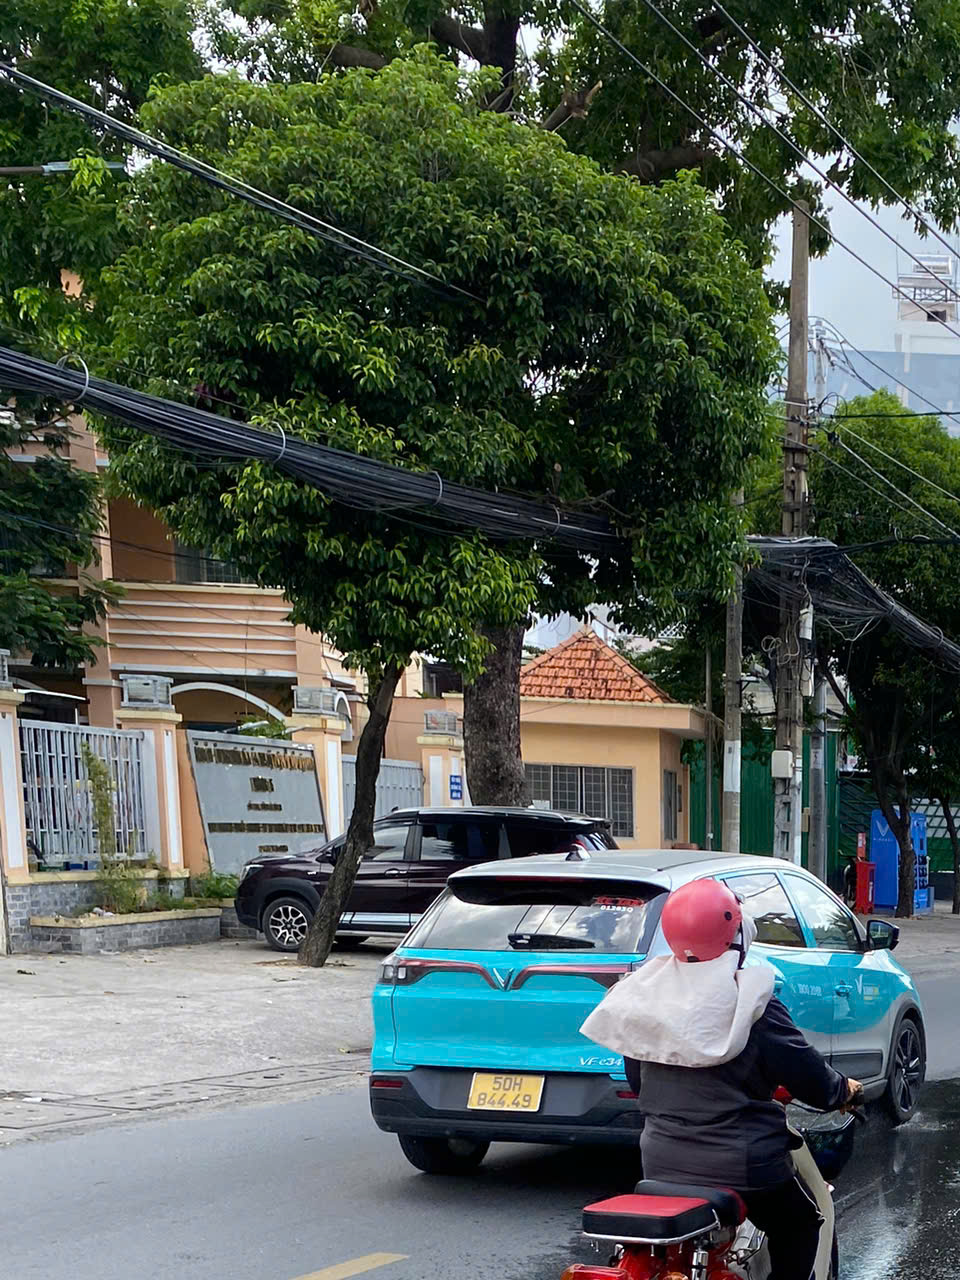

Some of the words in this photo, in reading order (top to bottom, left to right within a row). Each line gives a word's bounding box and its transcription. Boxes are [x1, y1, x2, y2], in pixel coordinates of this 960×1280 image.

[579, 1057, 598, 1066] VF
[492, 1076, 523, 1091] 50H
[477, 1092, 532, 1108] 844.49
